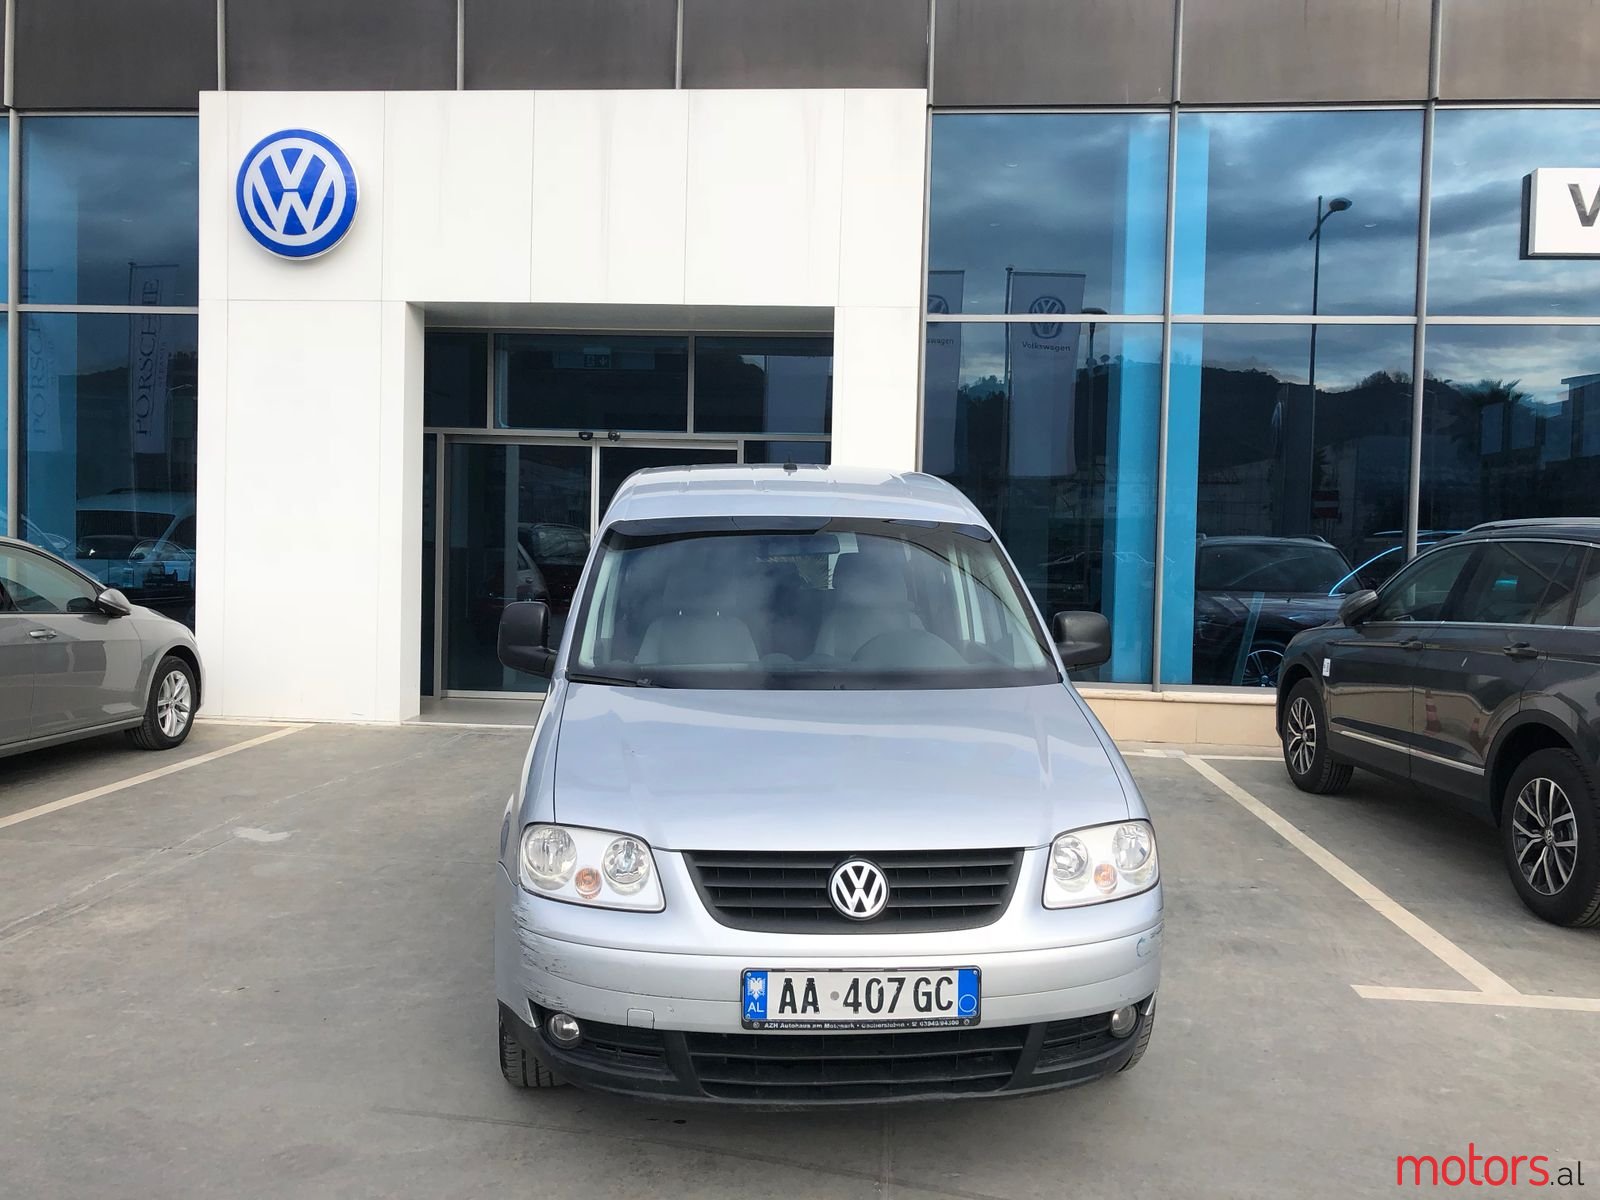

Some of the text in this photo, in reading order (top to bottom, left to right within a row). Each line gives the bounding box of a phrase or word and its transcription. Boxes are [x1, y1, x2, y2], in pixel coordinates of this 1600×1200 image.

[1022, 341, 1071, 352] Volkswagen
[778, 976, 953, 1014] AA 407 GC
[747, 1002, 764, 1013] AL
